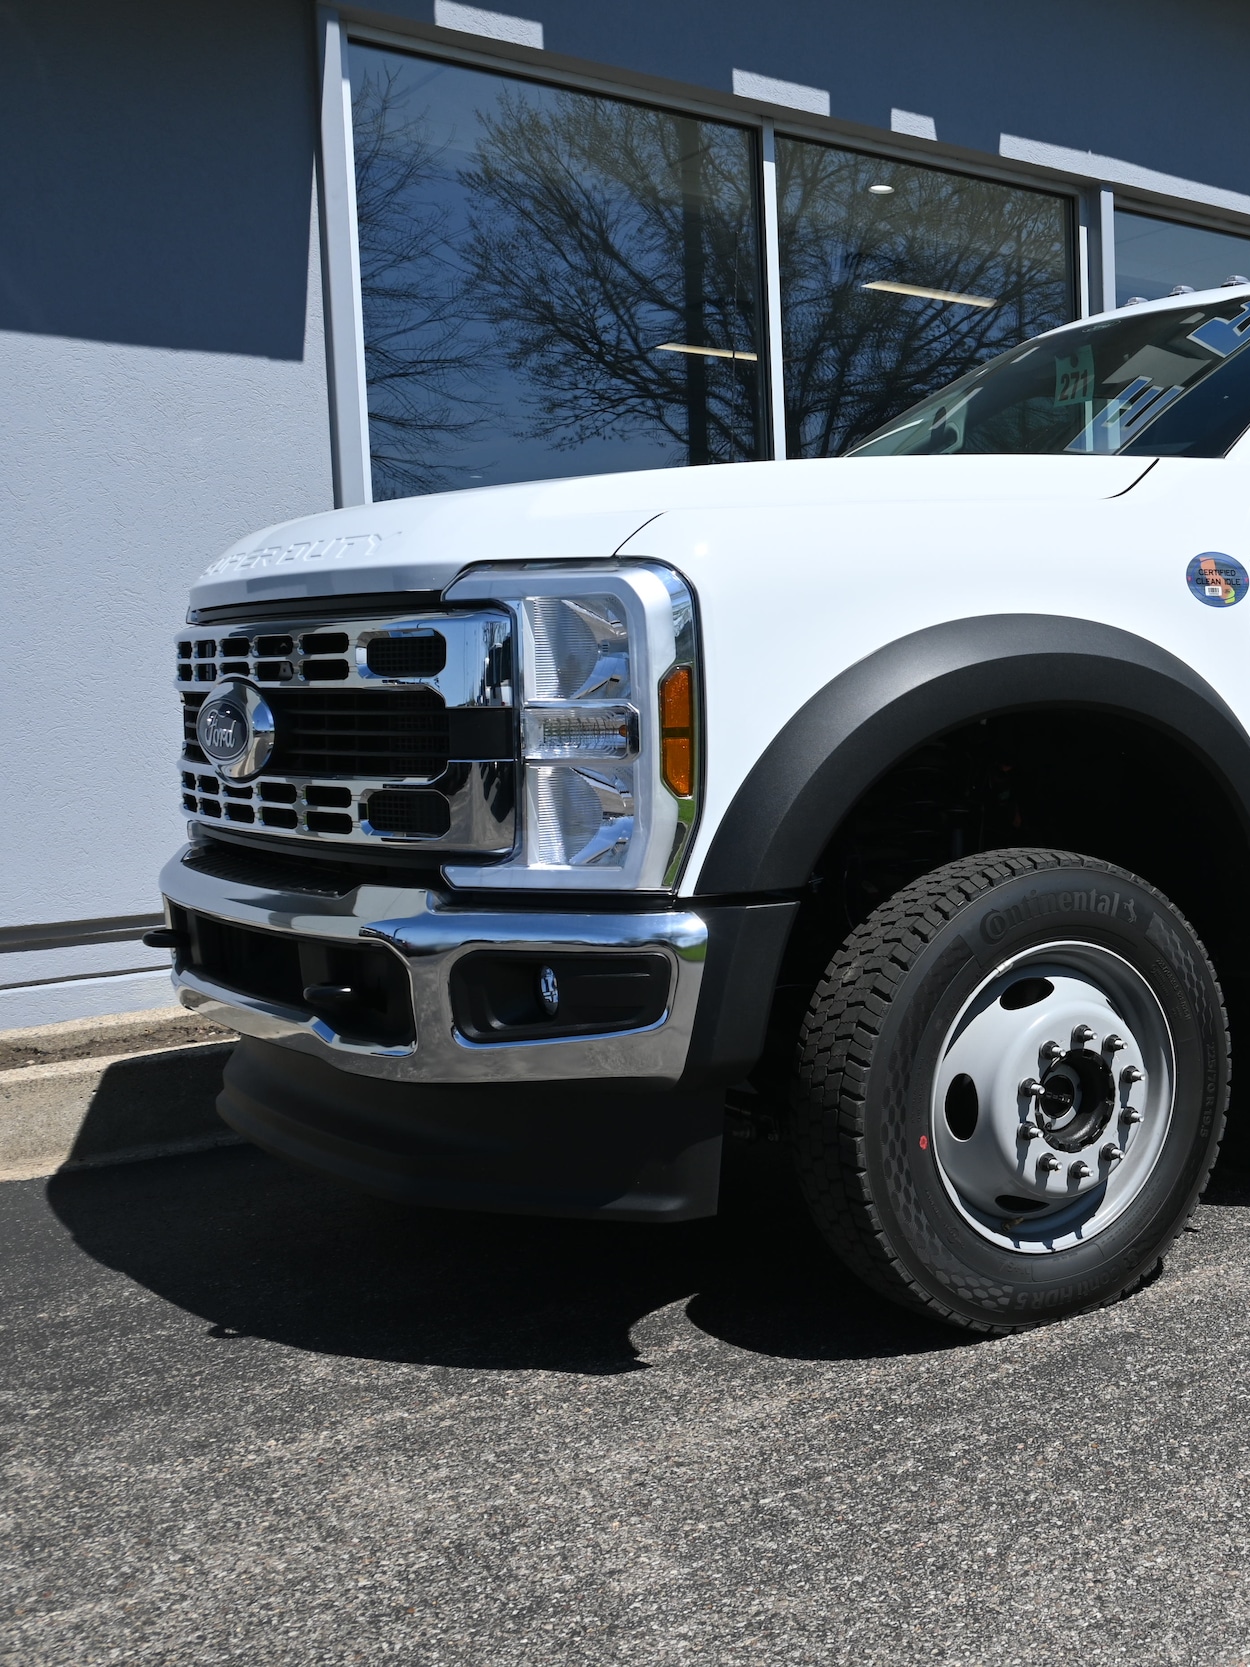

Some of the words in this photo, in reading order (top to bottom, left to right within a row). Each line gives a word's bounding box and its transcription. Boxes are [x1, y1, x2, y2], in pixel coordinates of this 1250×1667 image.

[1058, 369, 1088, 401] 271
[275, 530, 404, 565] DUTY
[1195, 577, 1221, 585] CLEAN
[1224, 578, 1241, 586] IDLE
[1198, 568, 1236, 577] CERTIFIED
[204, 708, 237, 748] Ford
[980, 888, 1121, 945] Continental
